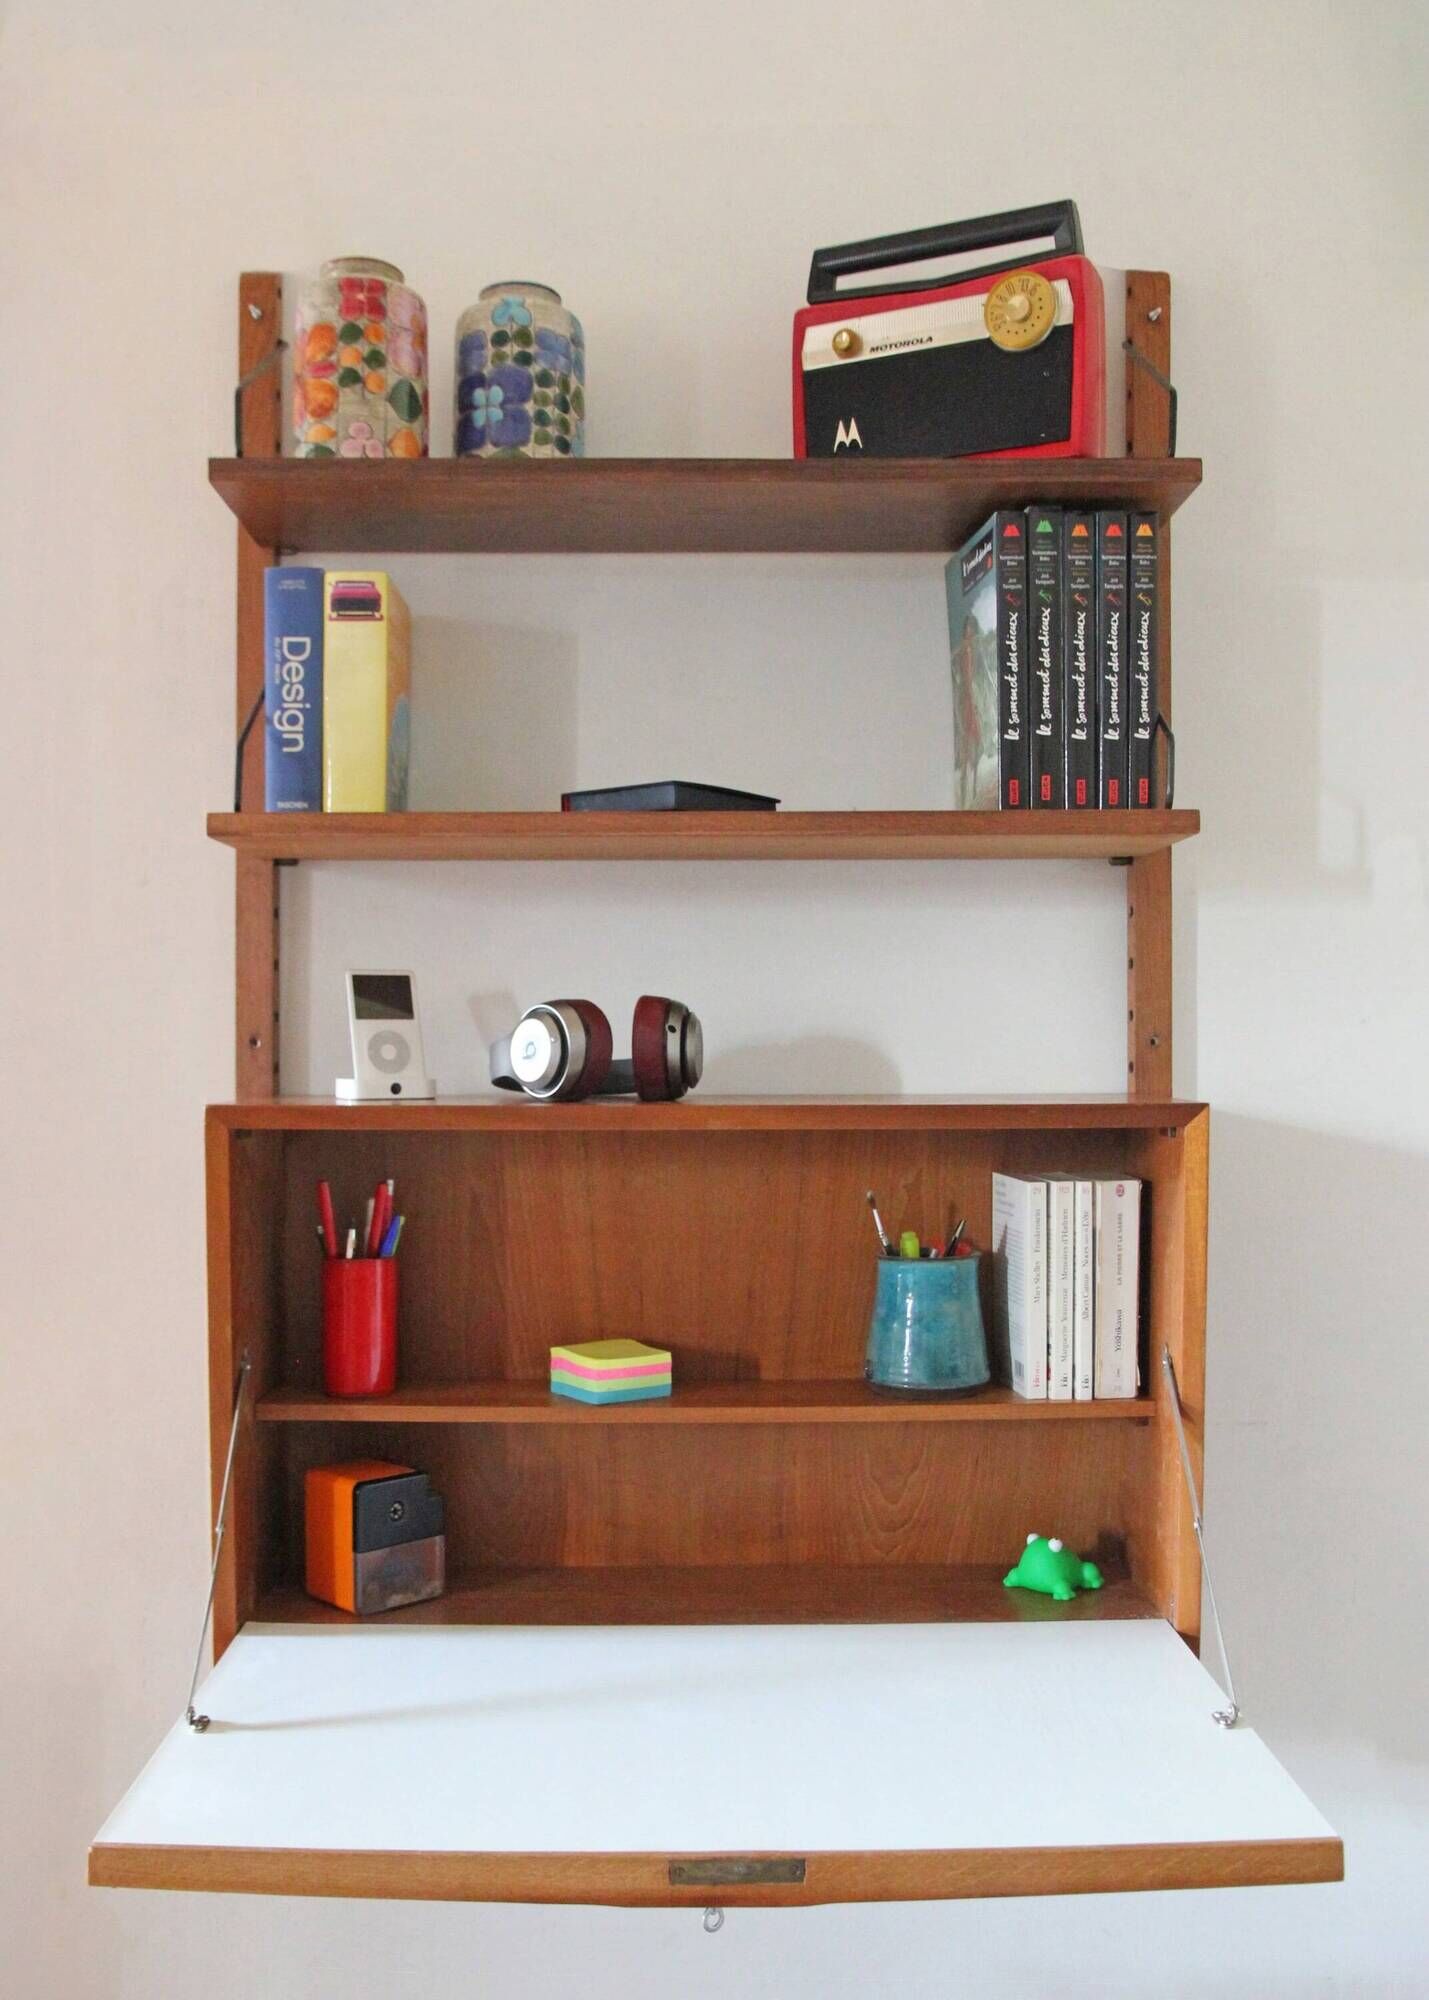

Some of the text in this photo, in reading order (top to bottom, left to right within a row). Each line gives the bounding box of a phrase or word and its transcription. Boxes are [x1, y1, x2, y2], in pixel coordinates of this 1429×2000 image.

[870, 335, 933, 353] MOTOROLA
[1005, 611, 1019, 651] dieux
[1038, 607, 1051, 647] dieux
[1073, 611, 1086, 651] dieux
[1106, 611, 1119, 651] dieux
[1137, 611, 1150, 650] dieux
[1006, 652, 1019, 672] des
[1038, 648, 1051, 668] des
[1074, 652, 1087, 672] des
[1107, 652, 1120, 672] des
[1137, 652, 1150, 671] des
[273, 636, 311, 752] Design
[1004, 673, 1020, 725] sommet
[1036, 669, 1052, 720] sommet
[1071, 672, 1087, 724] sommet
[1104, 672, 1120, 724] sommet
[1135, 672, 1150, 724] sommet
[1113, 1309, 1123, 1352] Yoshikawa
